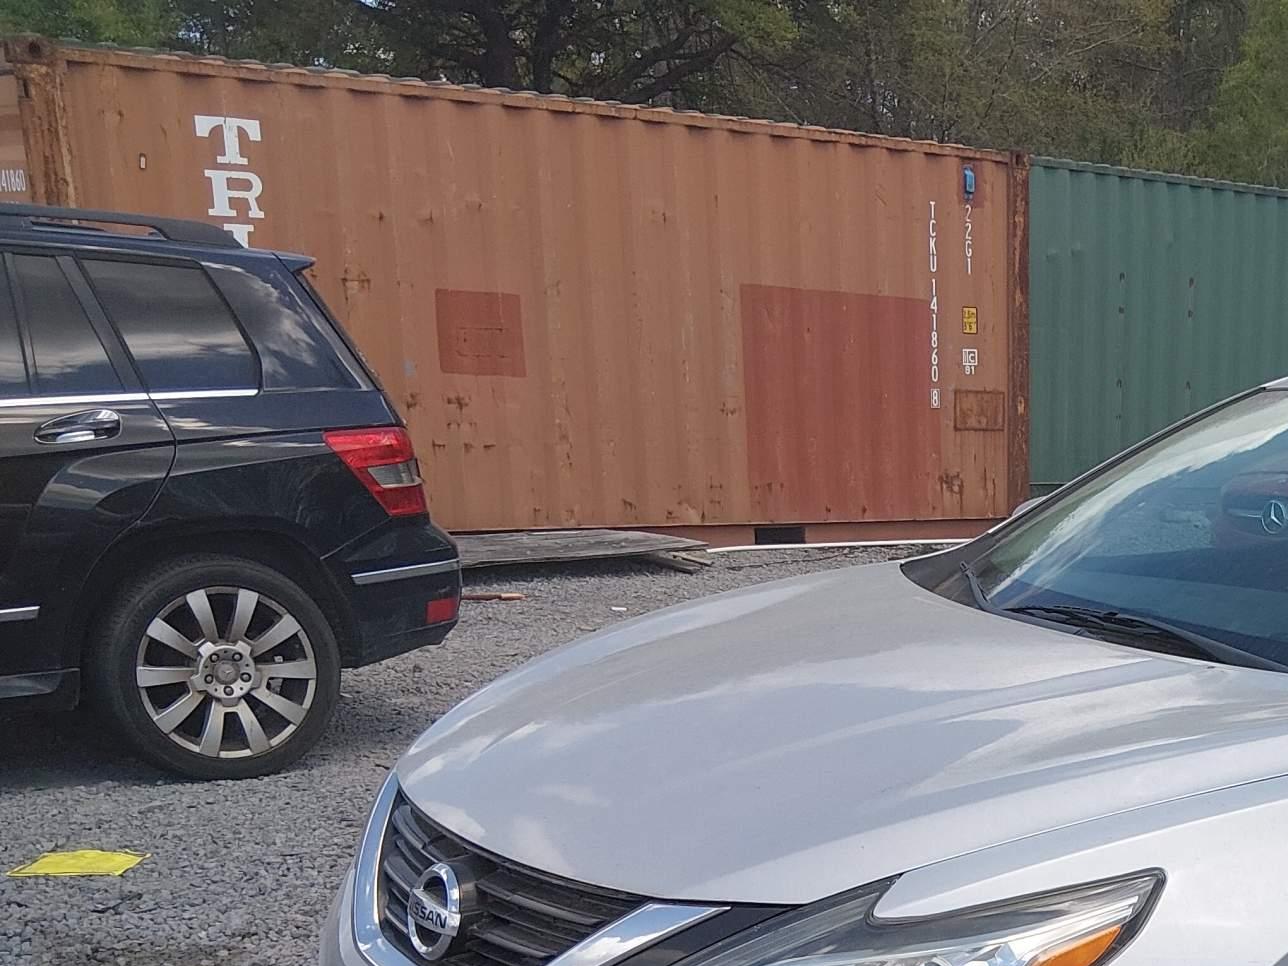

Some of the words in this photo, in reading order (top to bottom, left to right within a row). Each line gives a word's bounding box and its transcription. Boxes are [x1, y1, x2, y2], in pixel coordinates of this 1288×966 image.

[0, 169, 26, 192] 41860
[929, 201, 937, 272] TCKU
[930, 278, 939, 382] 141860
[931, 390, 939, 407] 8
[409, 900, 448, 929] ISSAN
